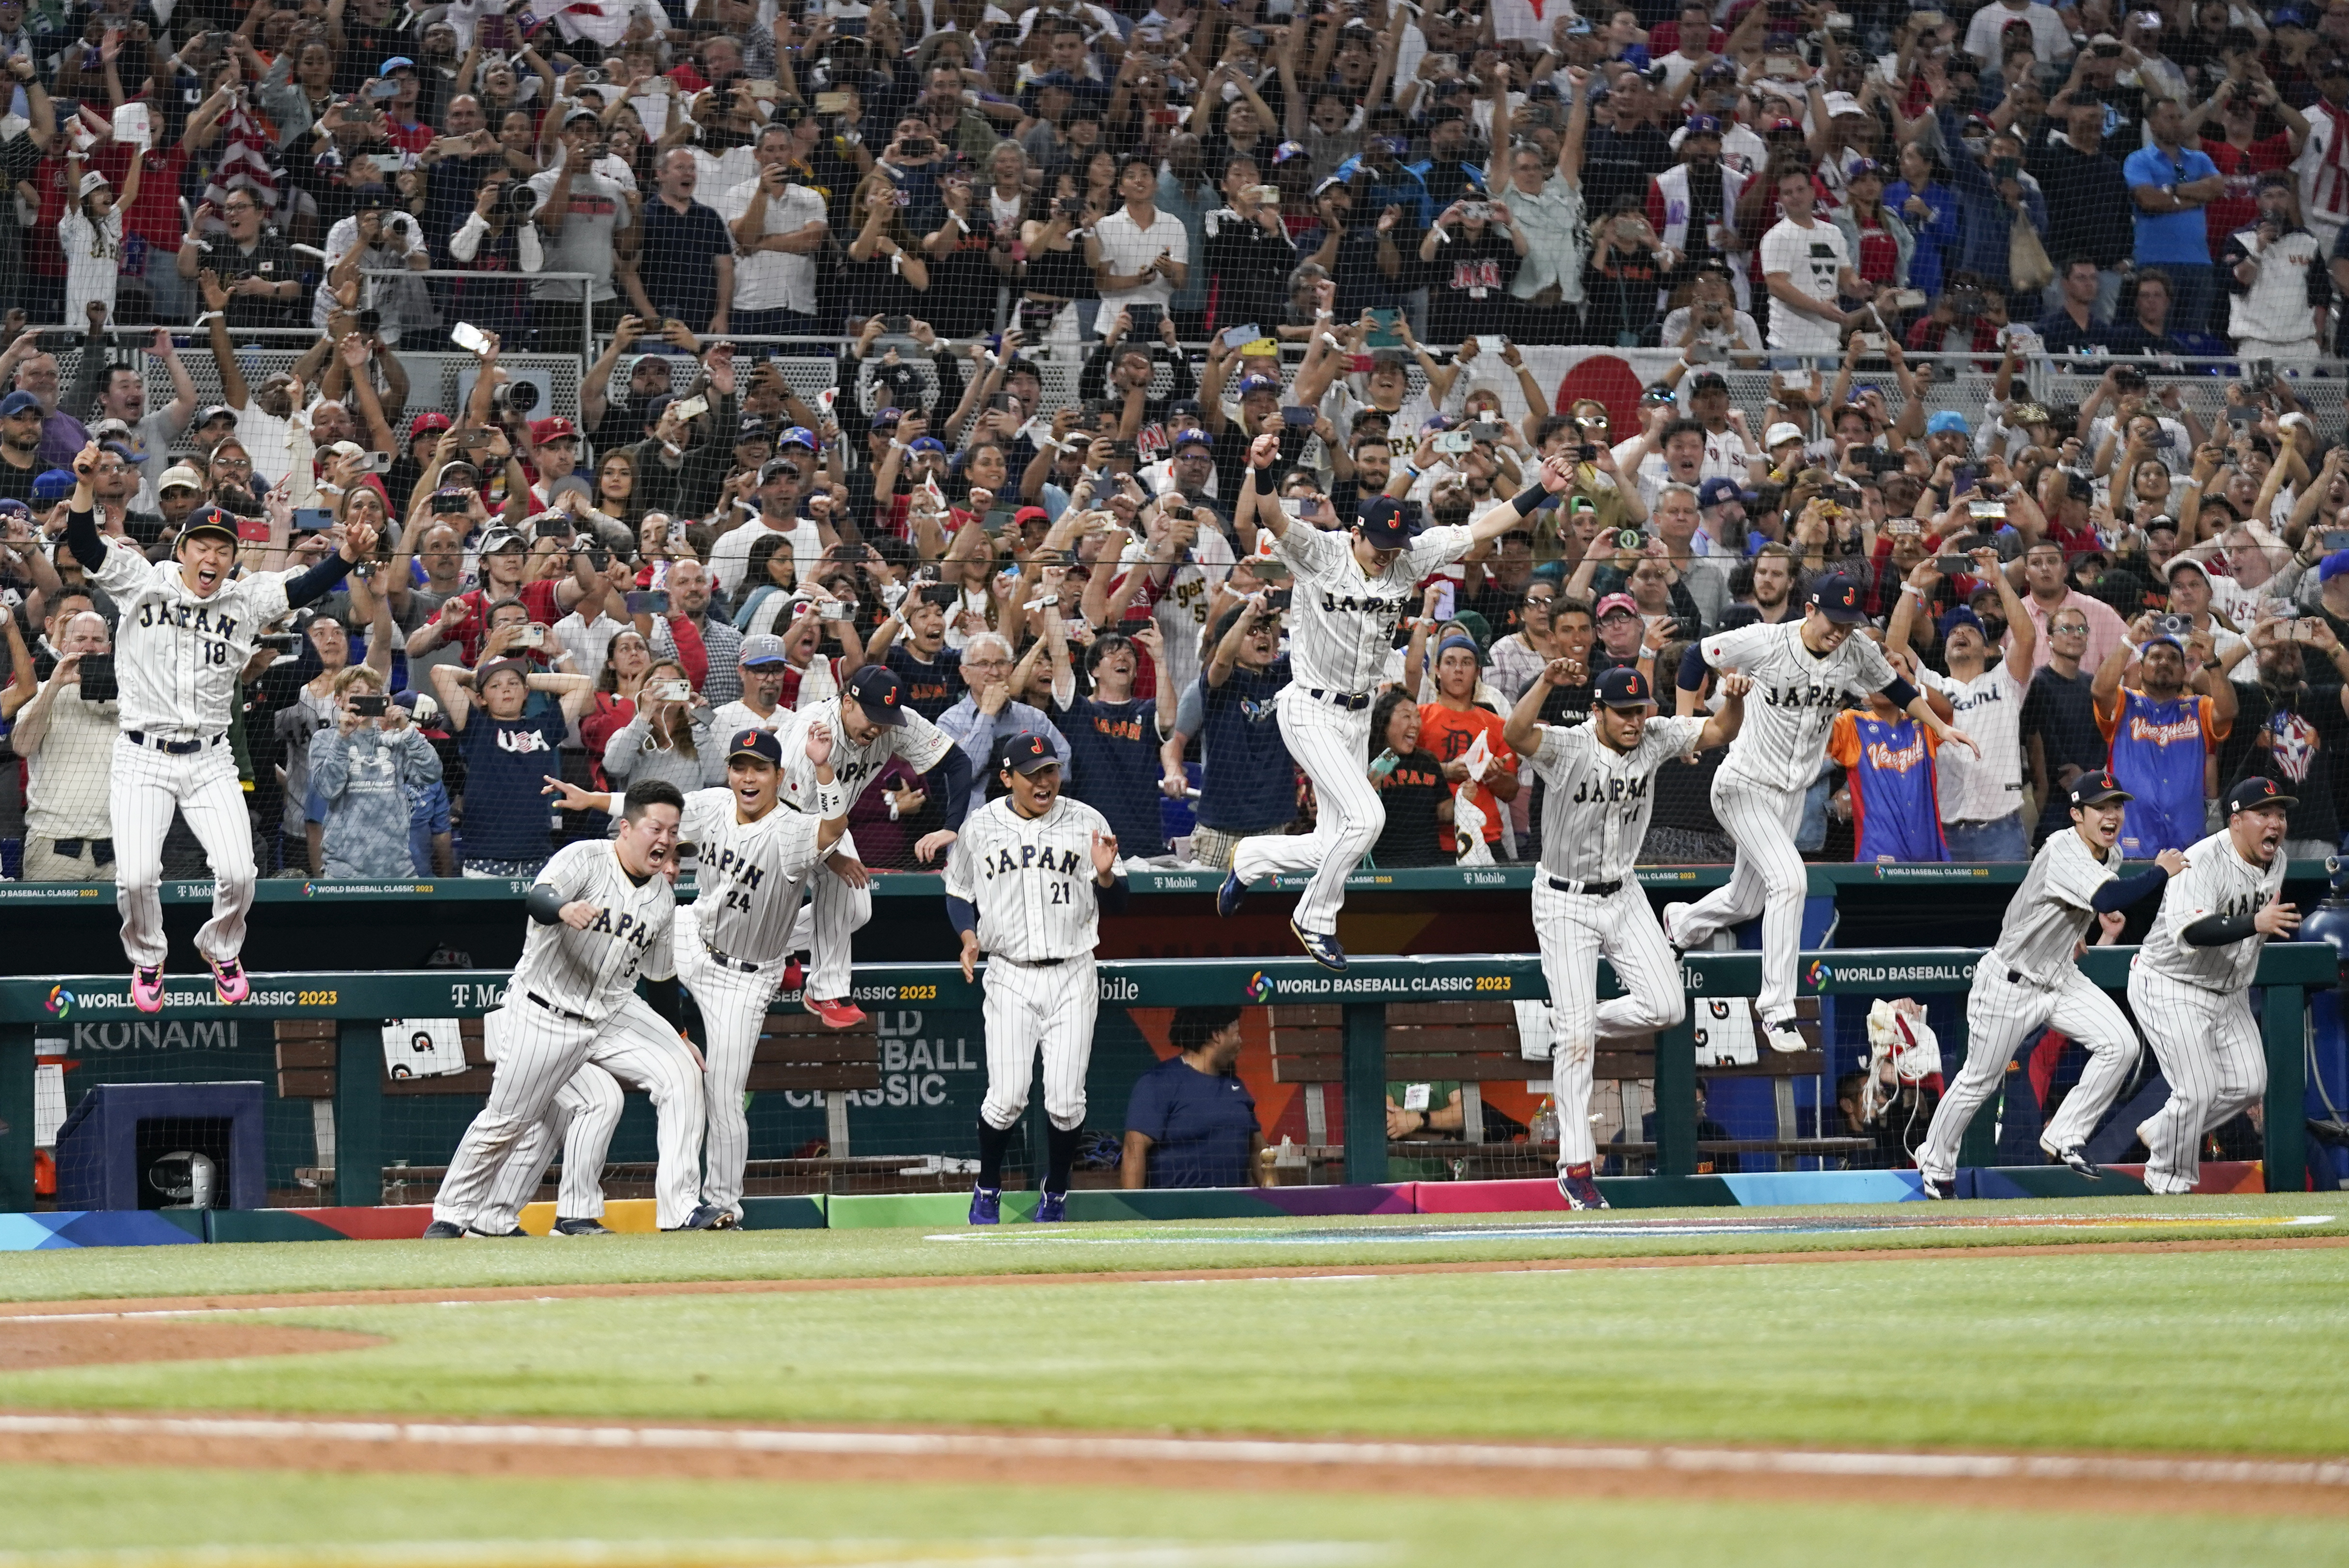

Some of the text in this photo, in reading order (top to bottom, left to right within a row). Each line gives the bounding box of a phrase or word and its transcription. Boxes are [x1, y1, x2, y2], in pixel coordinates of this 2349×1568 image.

[208, 508, 222, 524] J
[1388, 510, 1401, 529] J
[1843, 587, 1855, 605] J
[140, 602, 238, 640] JAPAN
[204, 641, 226, 665] 18
[1626, 676, 1638, 694] J
[883, 686, 897, 705] J
[497, 728, 551, 753] USA
[743, 731, 757, 747] J
[1031, 736, 1044, 753] J
[2101, 772, 2113, 788] J
[2264, 780, 2276, 795] J
[985, 845, 1080, 880] JAPAN
[1164, 876, 1197, 888] Mobile
[1474, 872, 1506, 884] Mobile
[189, 885, 213, 897] Mobi
[1050, 882, 1070, 904] 21
[726, 891, 751, 914] 24
[592, 908, 655, 955] APA
[1835, 967, 1886, 982] WORLD
[1888, 965, 1959, 980] BASEBALL
[852, 985, 936, 1002] ASSIC 2023
[1100, 977, 1139, 1000] bile
[1277, 976, 1511, 994] WORLD BASEBALL CLASSIC 2023
[78, 991, 338, 1008] WORLD SEBALL LASSIC 2023
[74, 1021, 237, 1049] KONAMI
